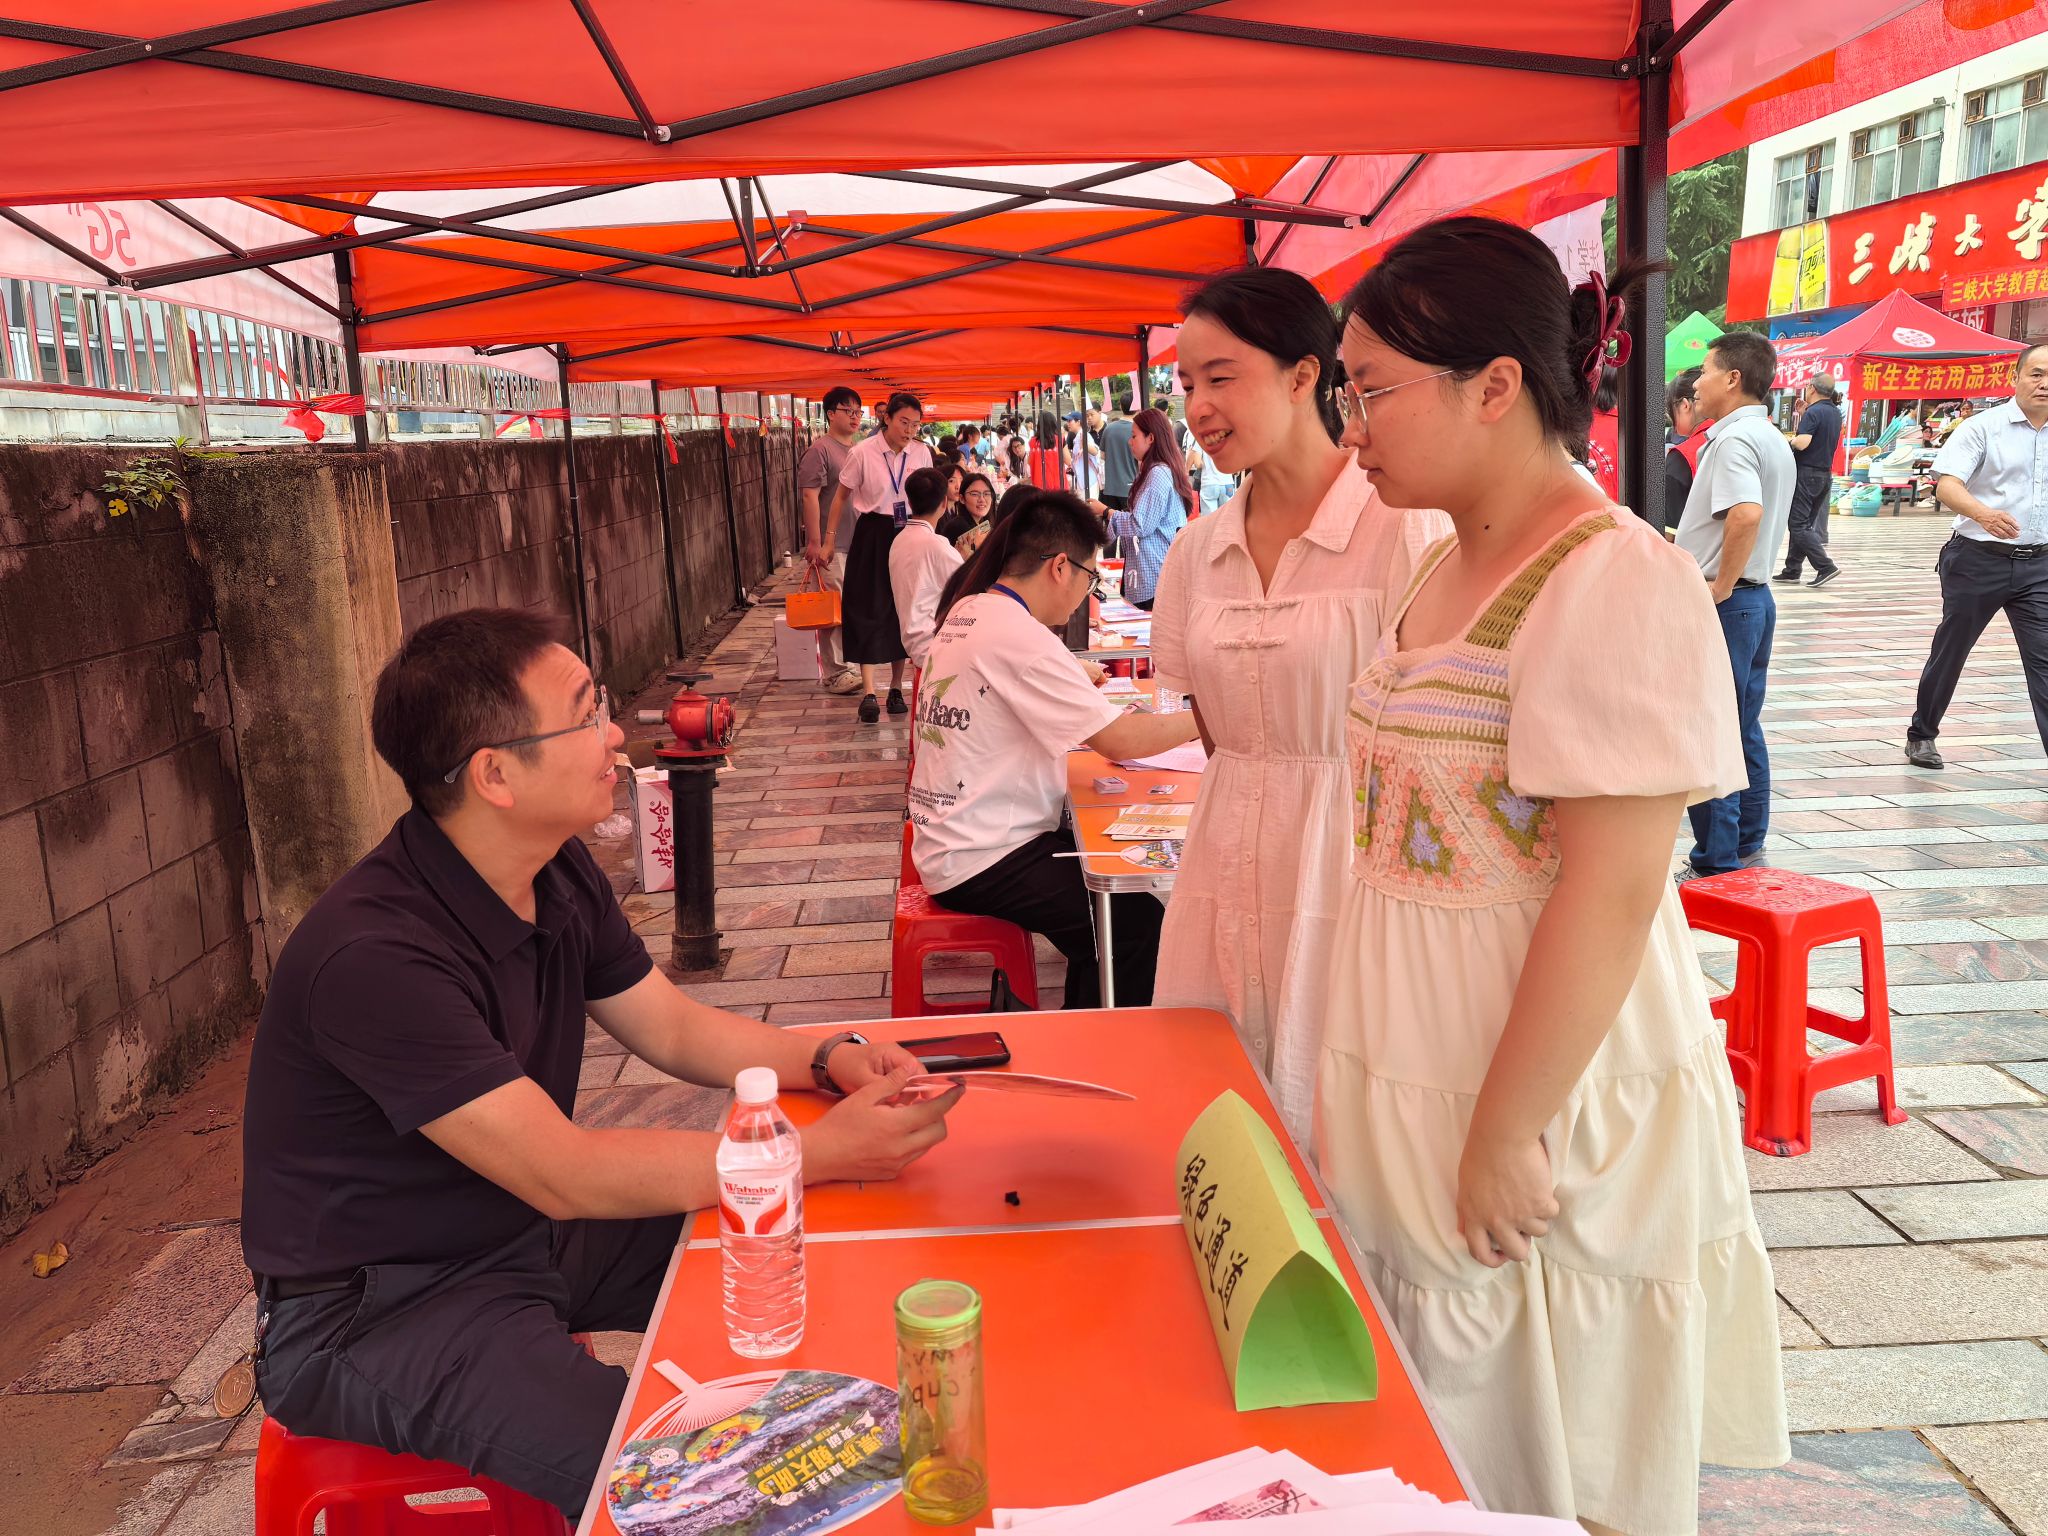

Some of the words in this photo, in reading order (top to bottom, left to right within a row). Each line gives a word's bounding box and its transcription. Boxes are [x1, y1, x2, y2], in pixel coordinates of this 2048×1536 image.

[649, 801, 675, 869] 娃哈哈
[724, 1182, 776, 1196] Wahaha
[1181, 1153, 1249, 1332] 绿色通道
